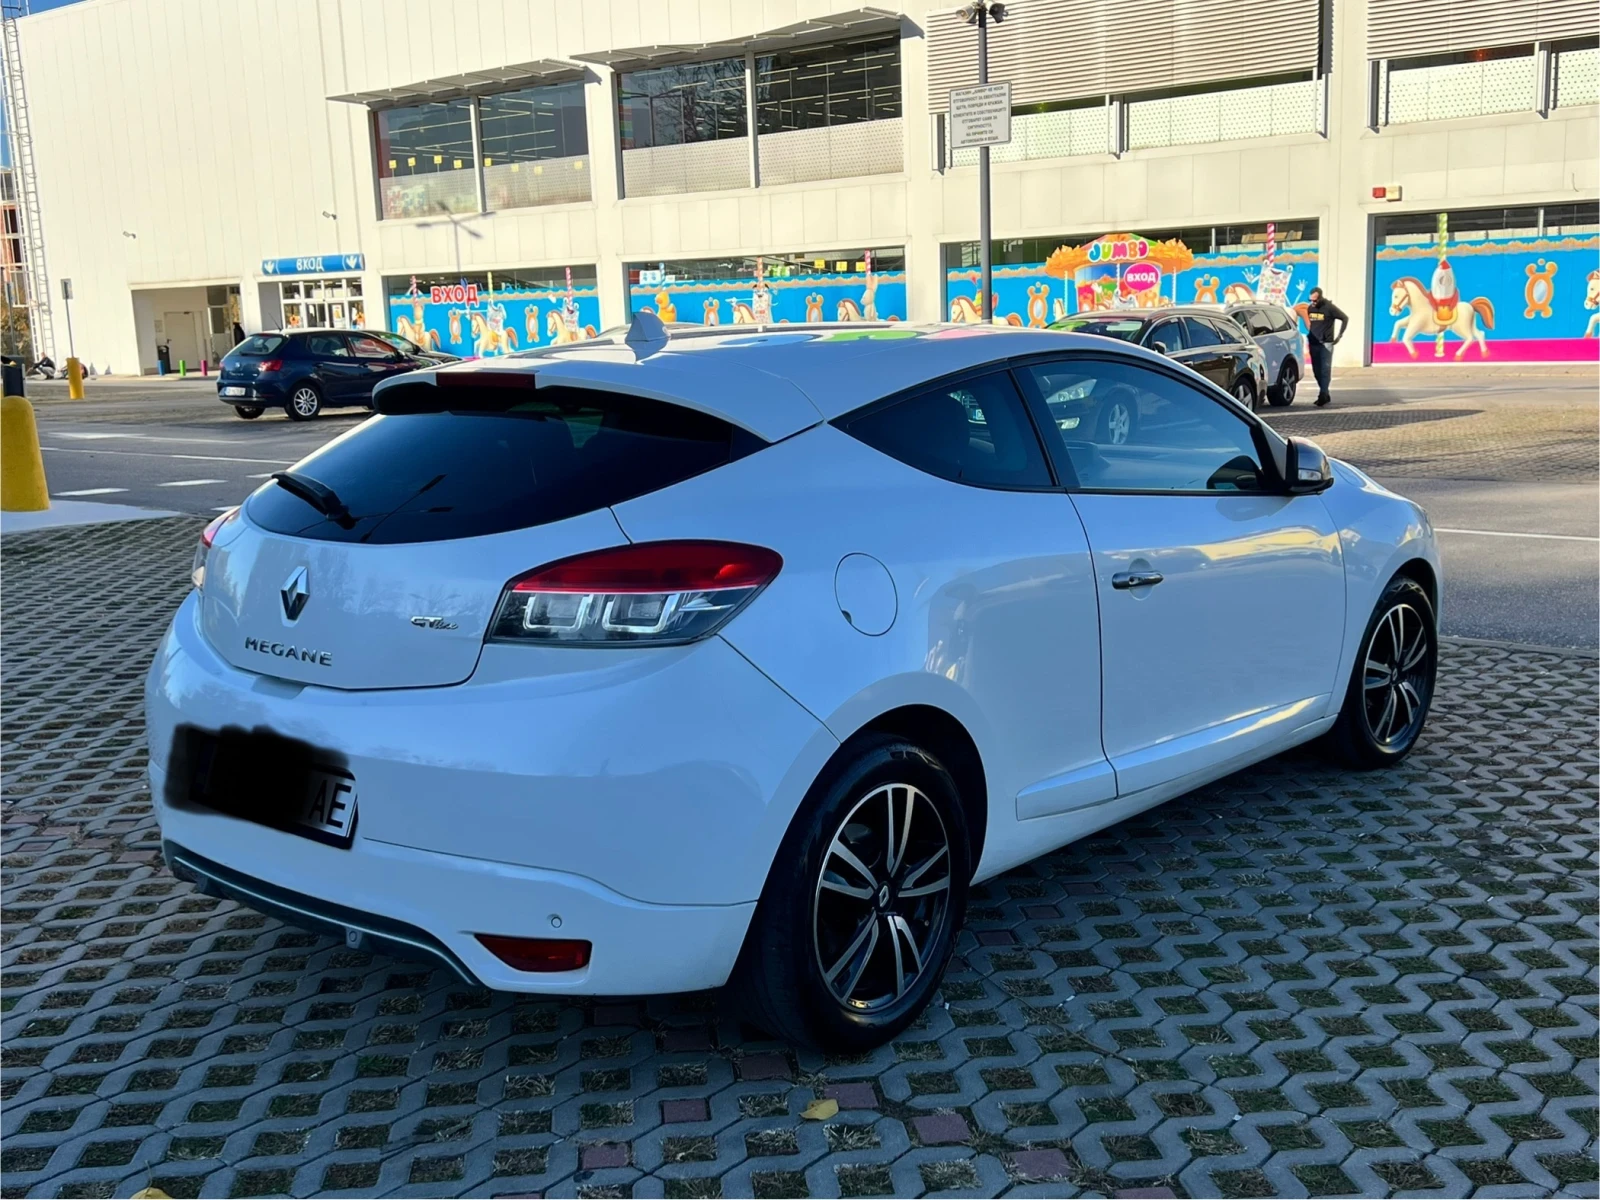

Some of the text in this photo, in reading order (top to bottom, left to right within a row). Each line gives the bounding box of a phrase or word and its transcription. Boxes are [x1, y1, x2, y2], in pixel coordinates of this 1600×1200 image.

[1089, 240, 1149, 262] JUMBO
[296, 256, 324, 272] ВХОД
[1126, 272, 1156, 283] ВХОД
[432, 286, 478, 308] ВХОД
[244, 636, 333, 667] MEGANE
